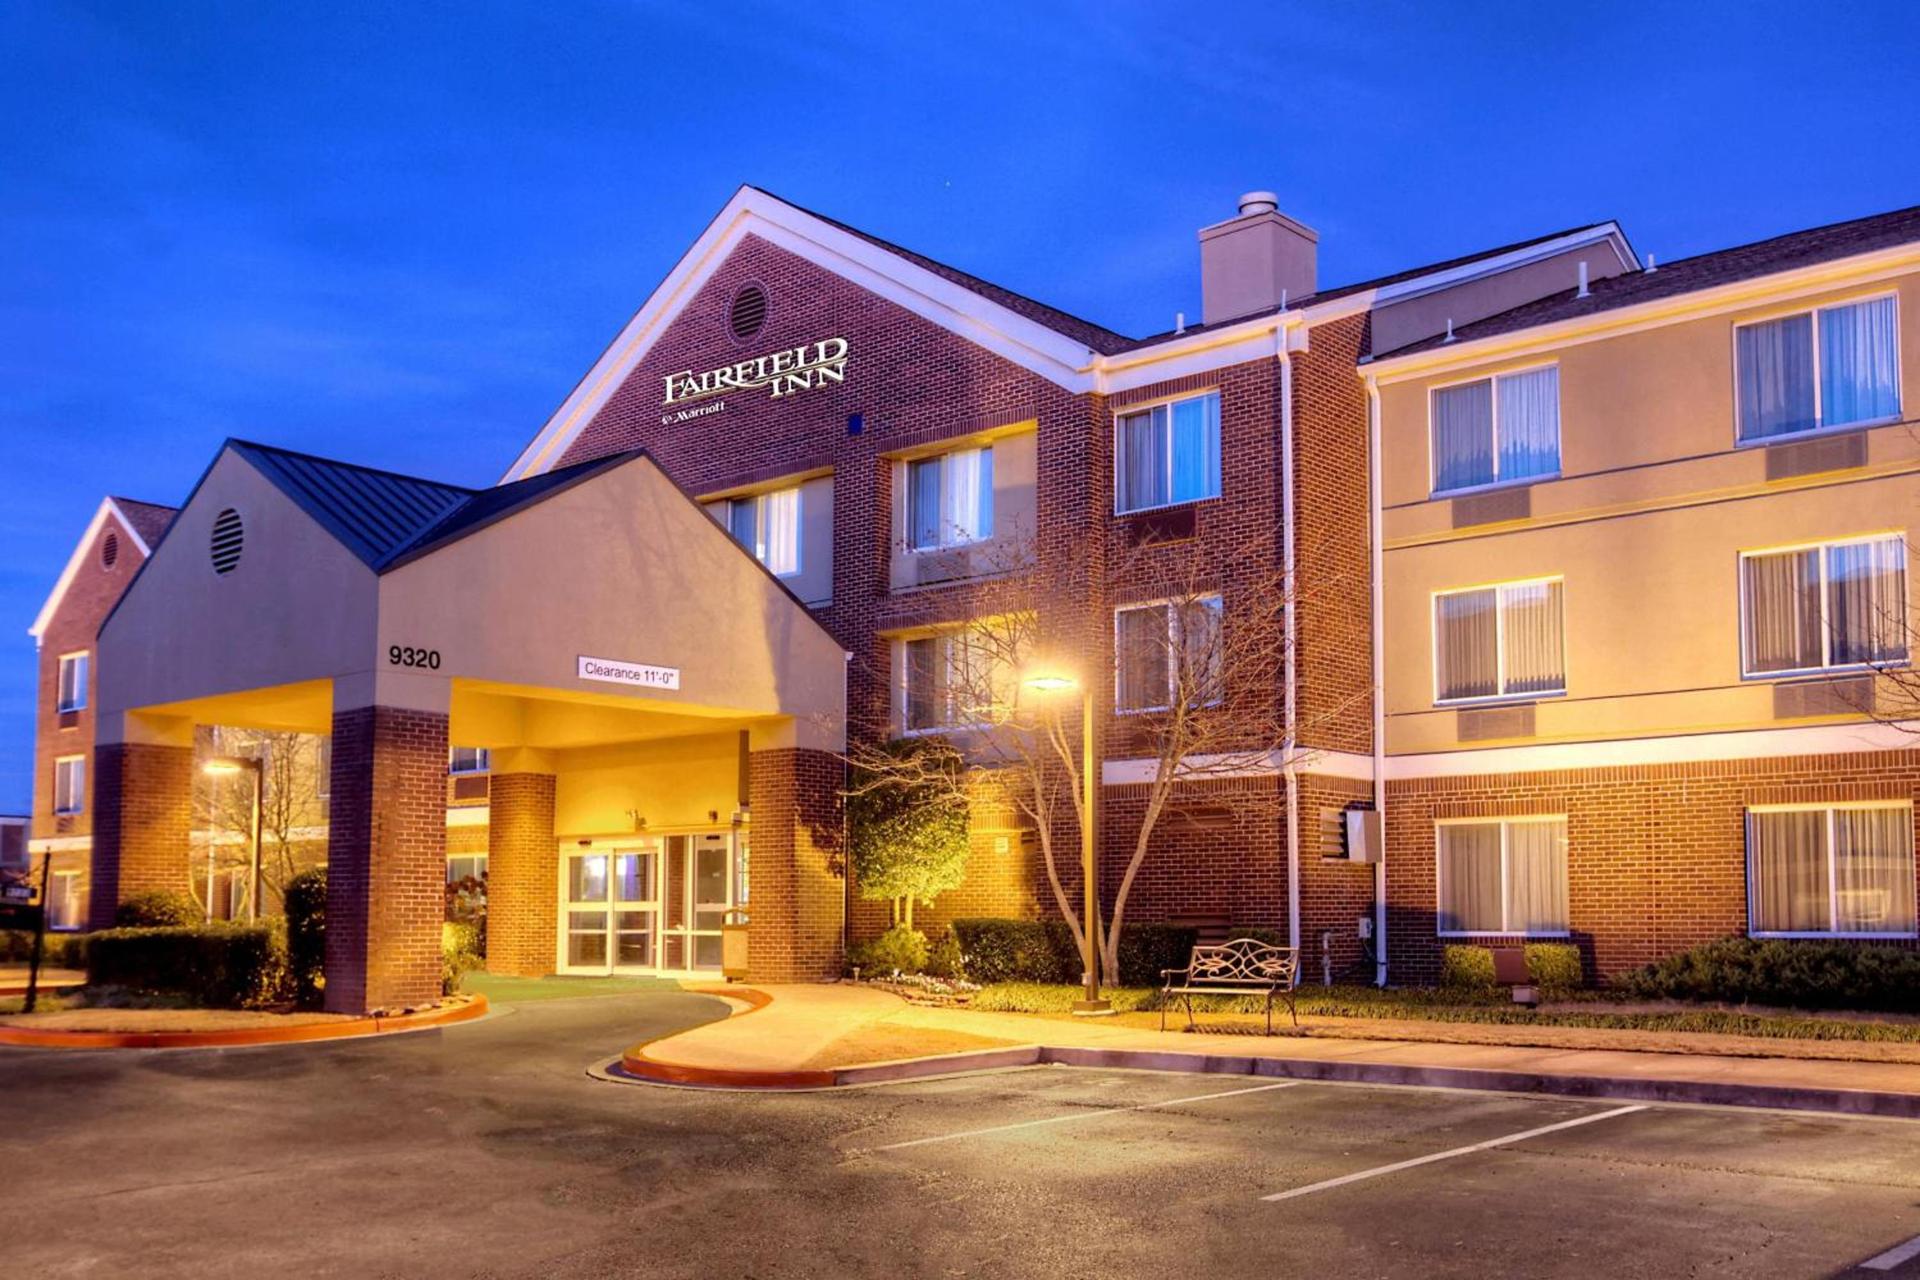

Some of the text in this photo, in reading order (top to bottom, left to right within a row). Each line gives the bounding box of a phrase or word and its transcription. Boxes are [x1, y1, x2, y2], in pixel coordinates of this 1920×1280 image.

[663, 337, 848, 403] FAIRFIELD
[770, 361, 846, 398] INN
[674, 401, 725, 423] Marriott
[389, 645, 441, 670] 9320
[585, 662, 640, 680] Clearance
